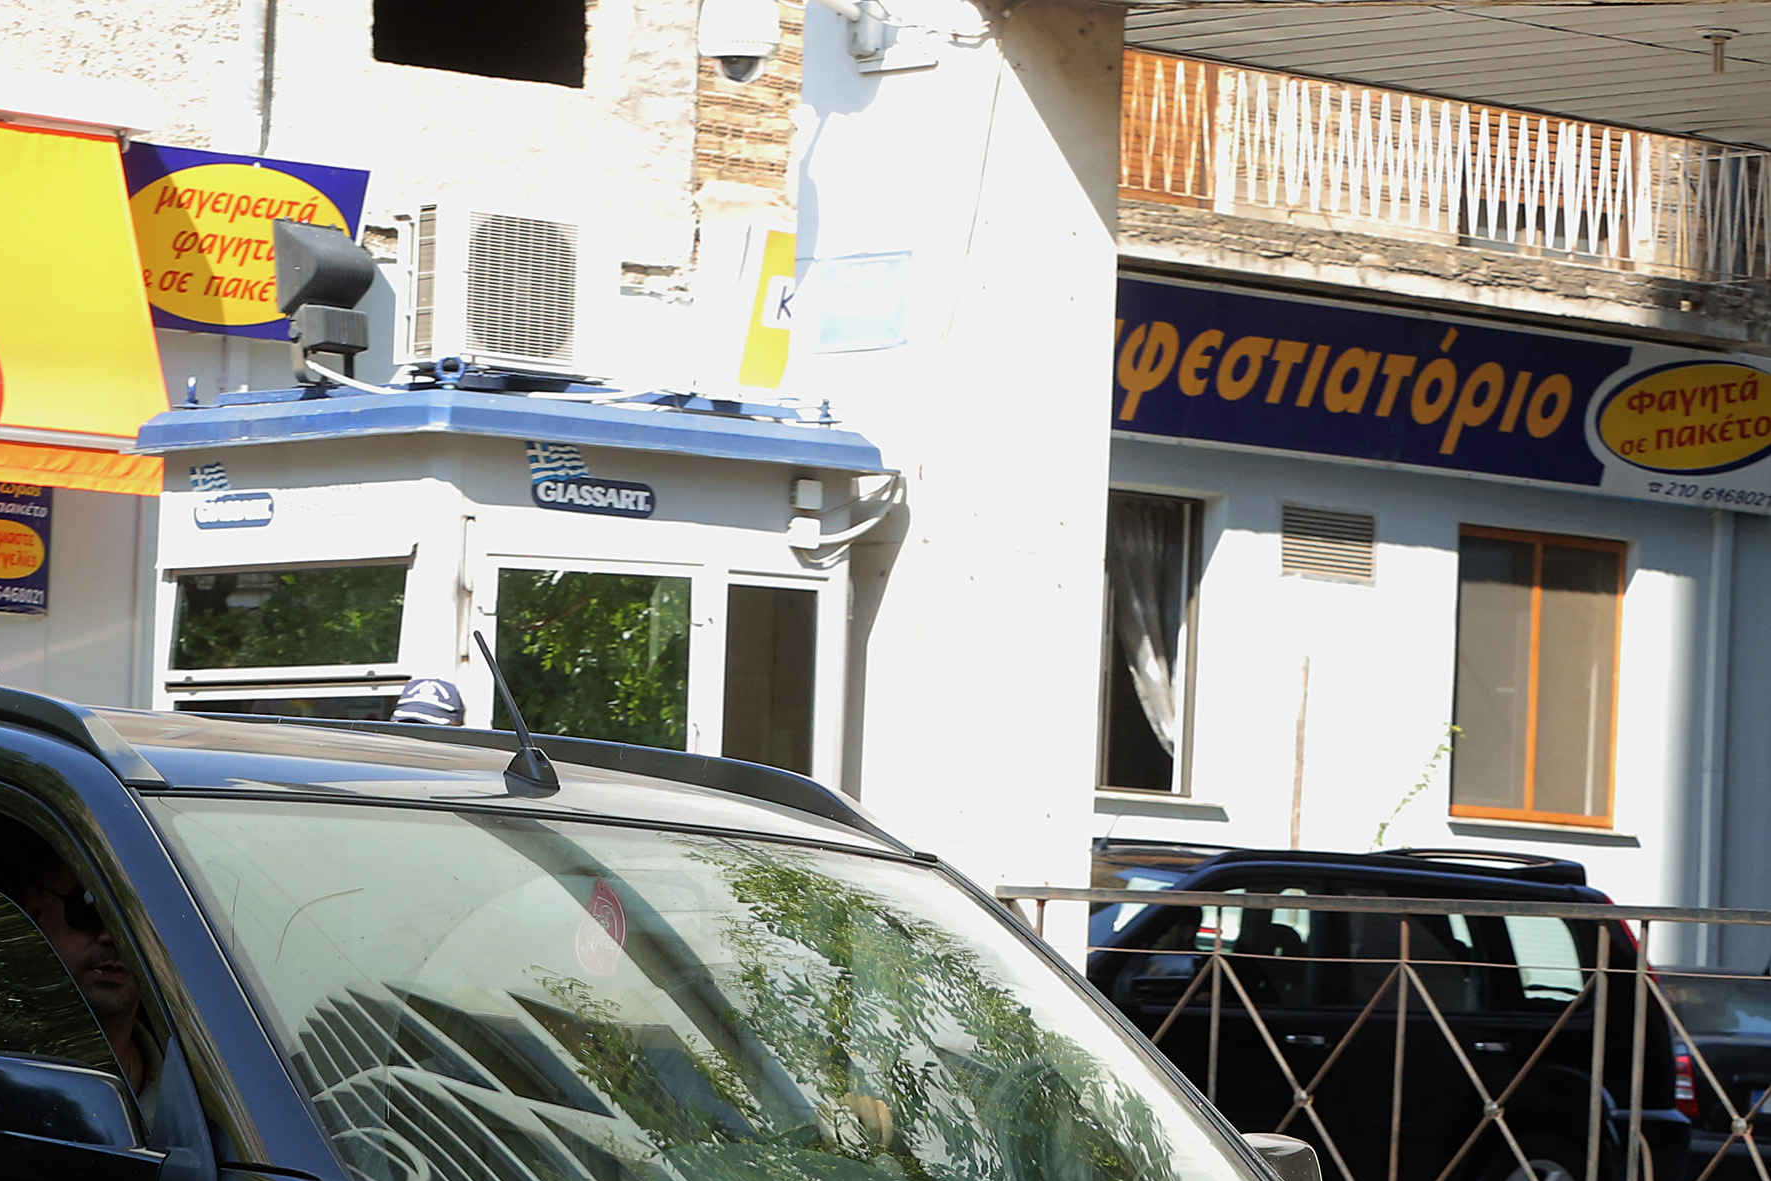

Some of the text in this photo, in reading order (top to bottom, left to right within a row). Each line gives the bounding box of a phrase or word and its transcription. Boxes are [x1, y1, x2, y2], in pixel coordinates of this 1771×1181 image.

[154, 185, 320, 224] μαγειρευτά
[159, 270, 195, 293] σε
[204, 275, 277, 303] πακέ
[1115, 321, 1573, 455] φεστιατόριο
[1620, 438, 1648, 456] σε
